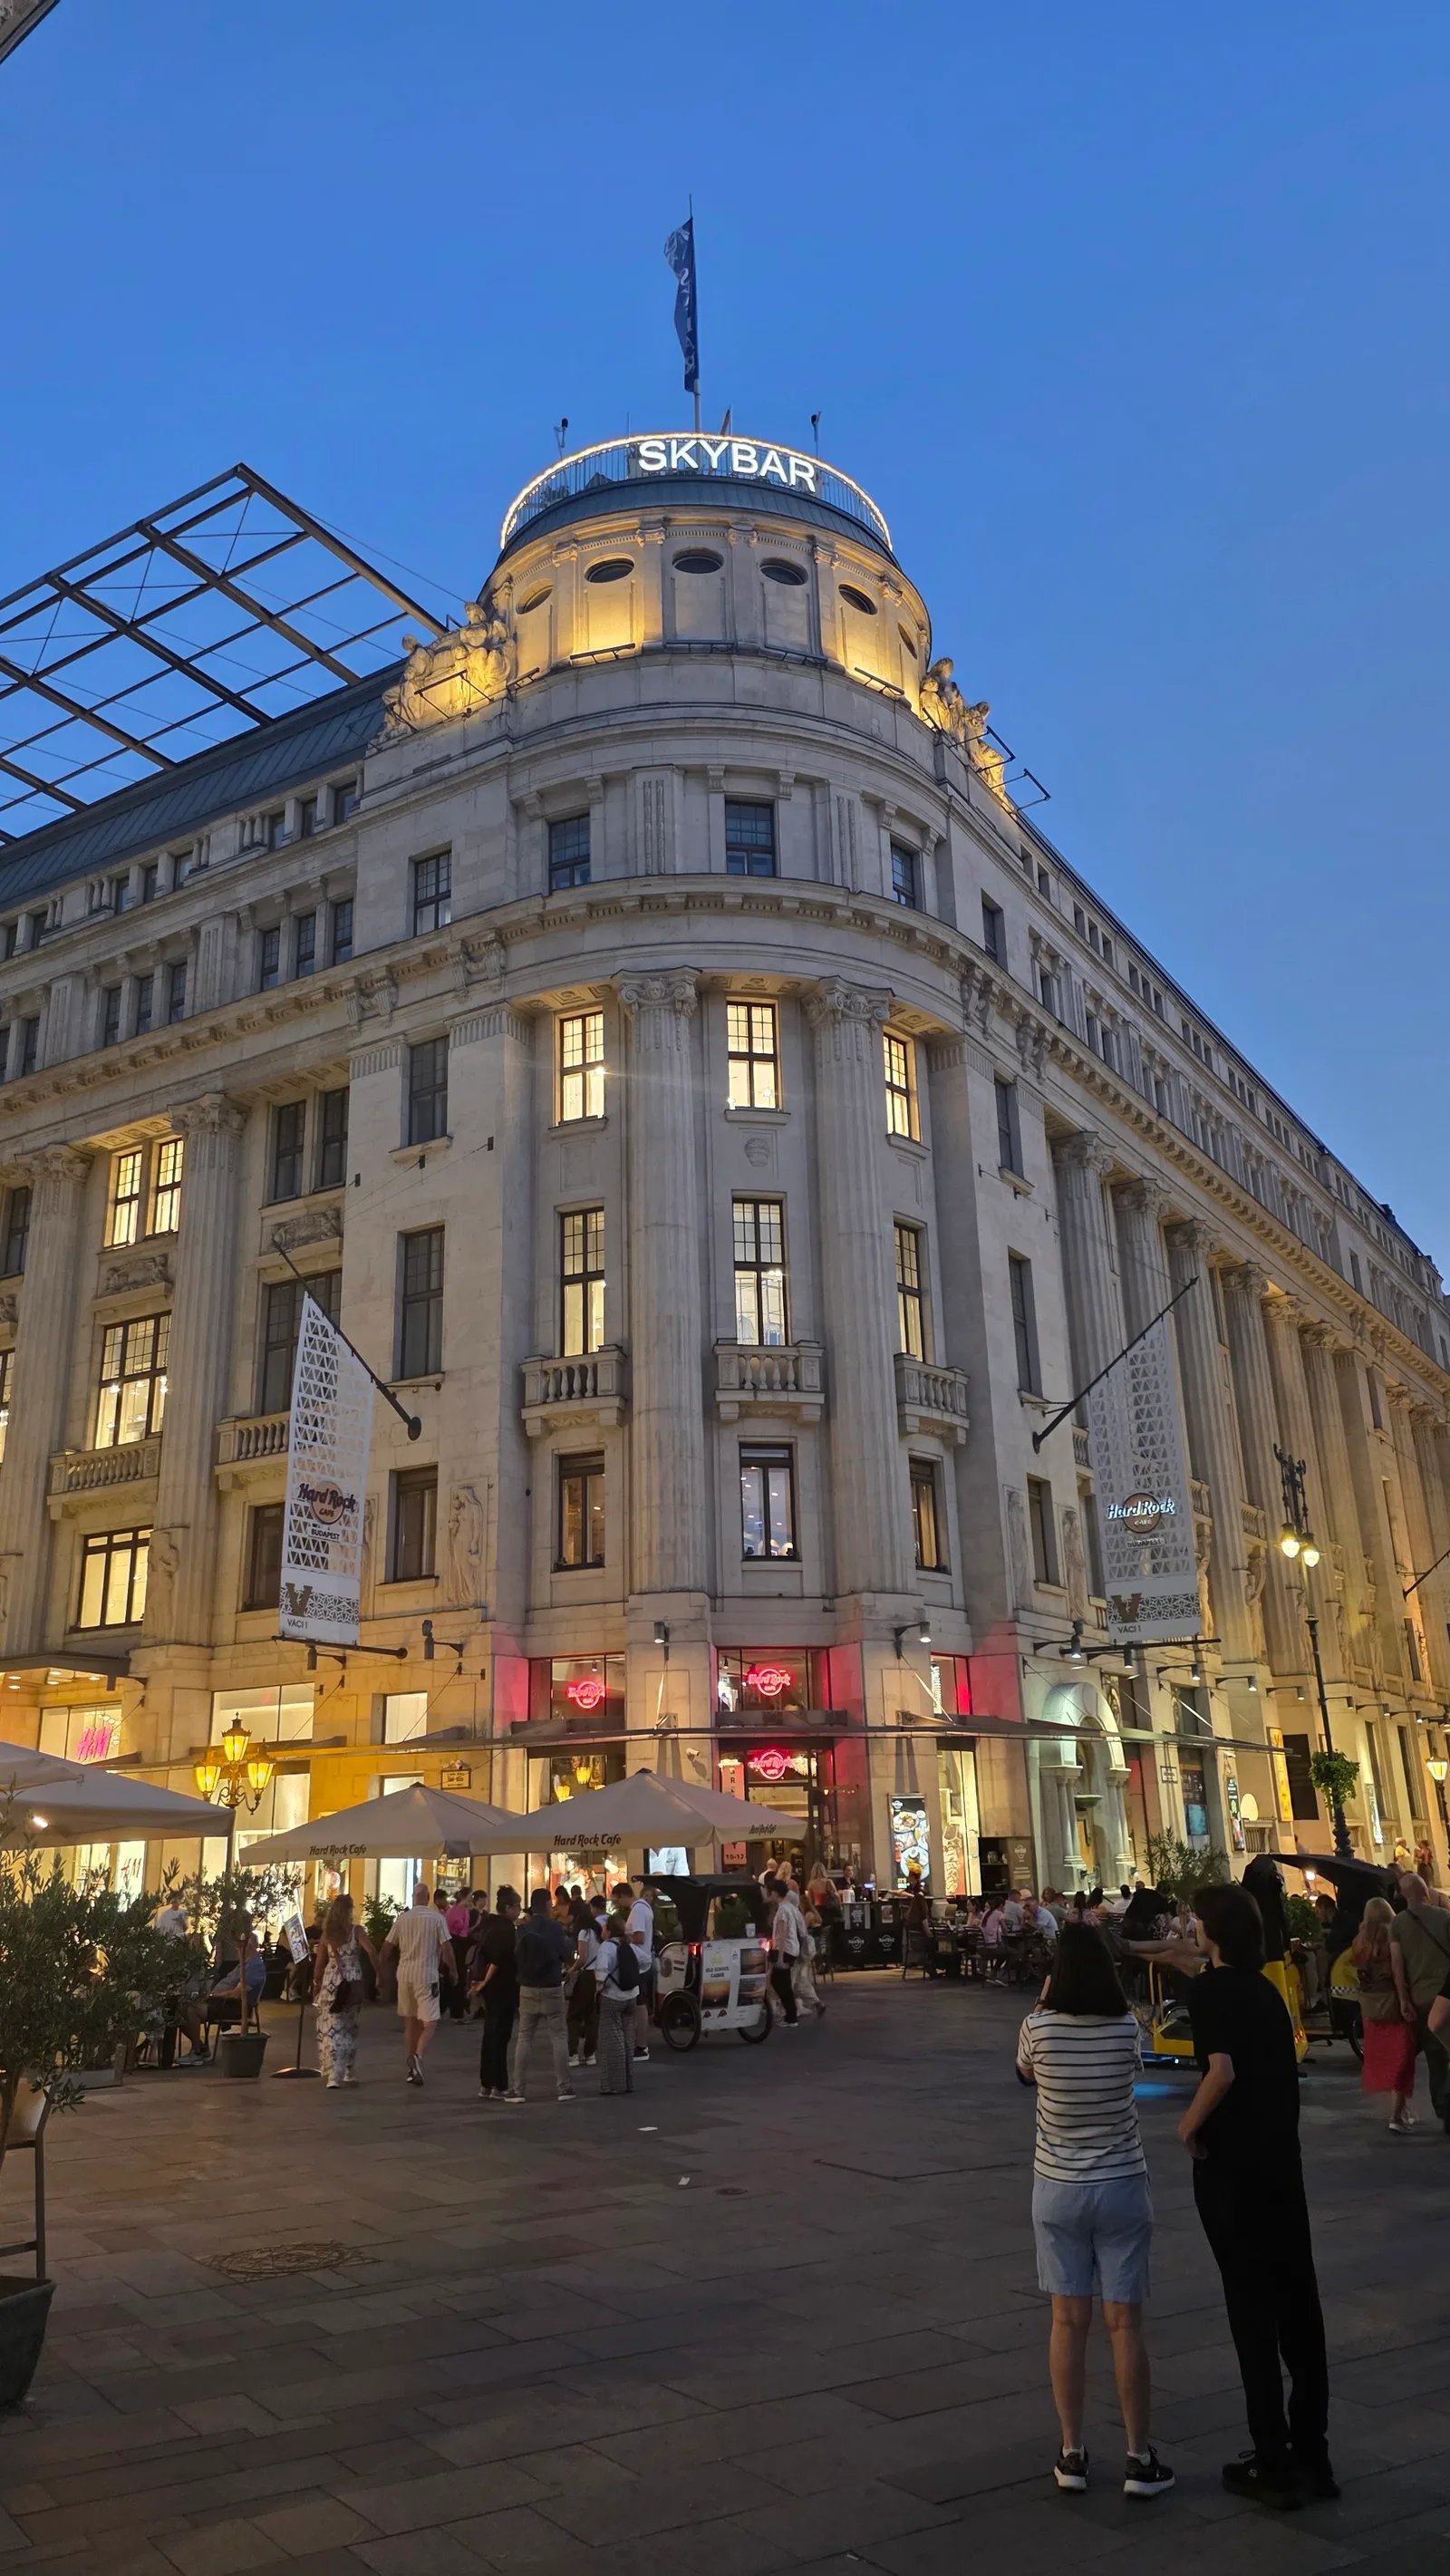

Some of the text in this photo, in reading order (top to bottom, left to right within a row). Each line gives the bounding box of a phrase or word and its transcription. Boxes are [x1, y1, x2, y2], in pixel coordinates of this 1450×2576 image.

[638, 439, 817, 493] SKYBAR
[297, 1482, 356, 1513] Hard Rock
[1107, 1497, 1175, 1519] Hard Rock
[311, 1528, 341, 1541] BUDAPEST
[76, 1725, 113, 1760] H&M
[309, 1843, 367, 1857] Hard Rock Cafe
[554, 1833, 622, 1847] Hard Rock Cafe
